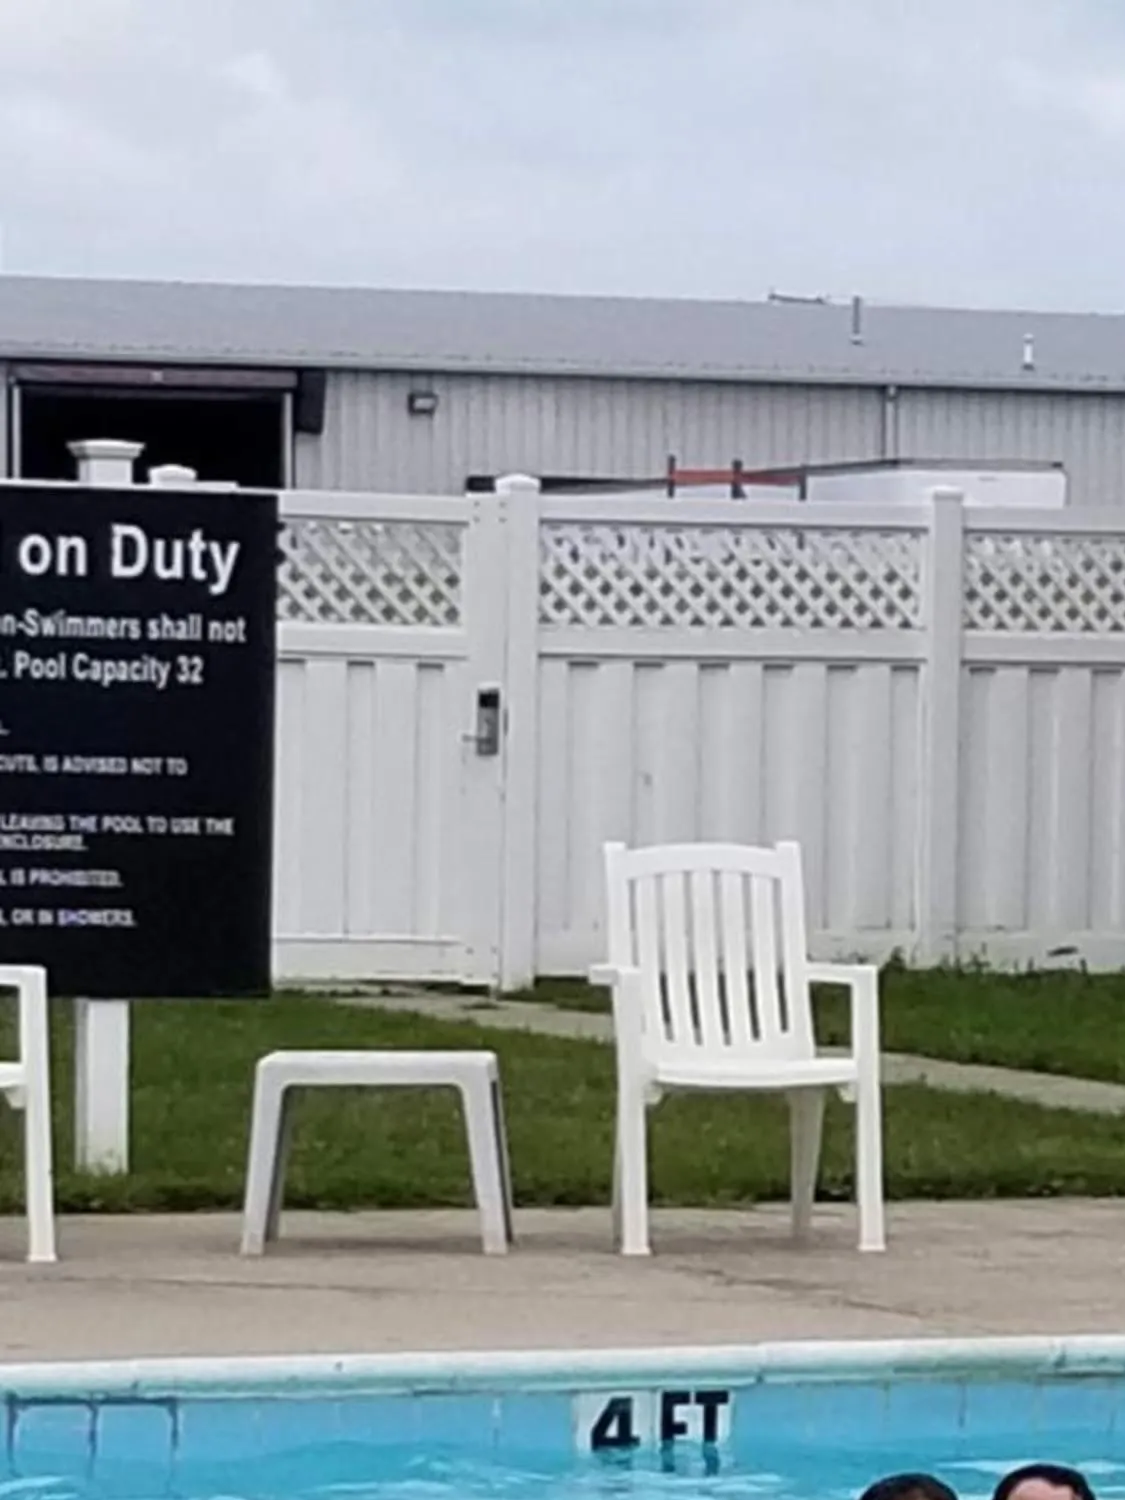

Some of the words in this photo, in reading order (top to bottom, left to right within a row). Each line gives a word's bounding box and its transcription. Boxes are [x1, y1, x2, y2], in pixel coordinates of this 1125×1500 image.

[18, 533, 88, 577] on
[110, 522, 241, 596] Duty
[148, 612, 203, 641] shall
[208, 616, 247, 643] not
[14, 650, 66, 680] Pool
[72, 651, 170, 690] Capacity
[176, 654, 204, 684] 32
[130, 757, 163, 775] NOT
[166, 757, 188, 776] TO
[69, 815, 98, 833] THE
[147, 816, 168, 834] TO
[205, 817, 235, 835] THE
[590, 1396, 641, 1454] 4
[660, 1389, 729, 1455] FT
